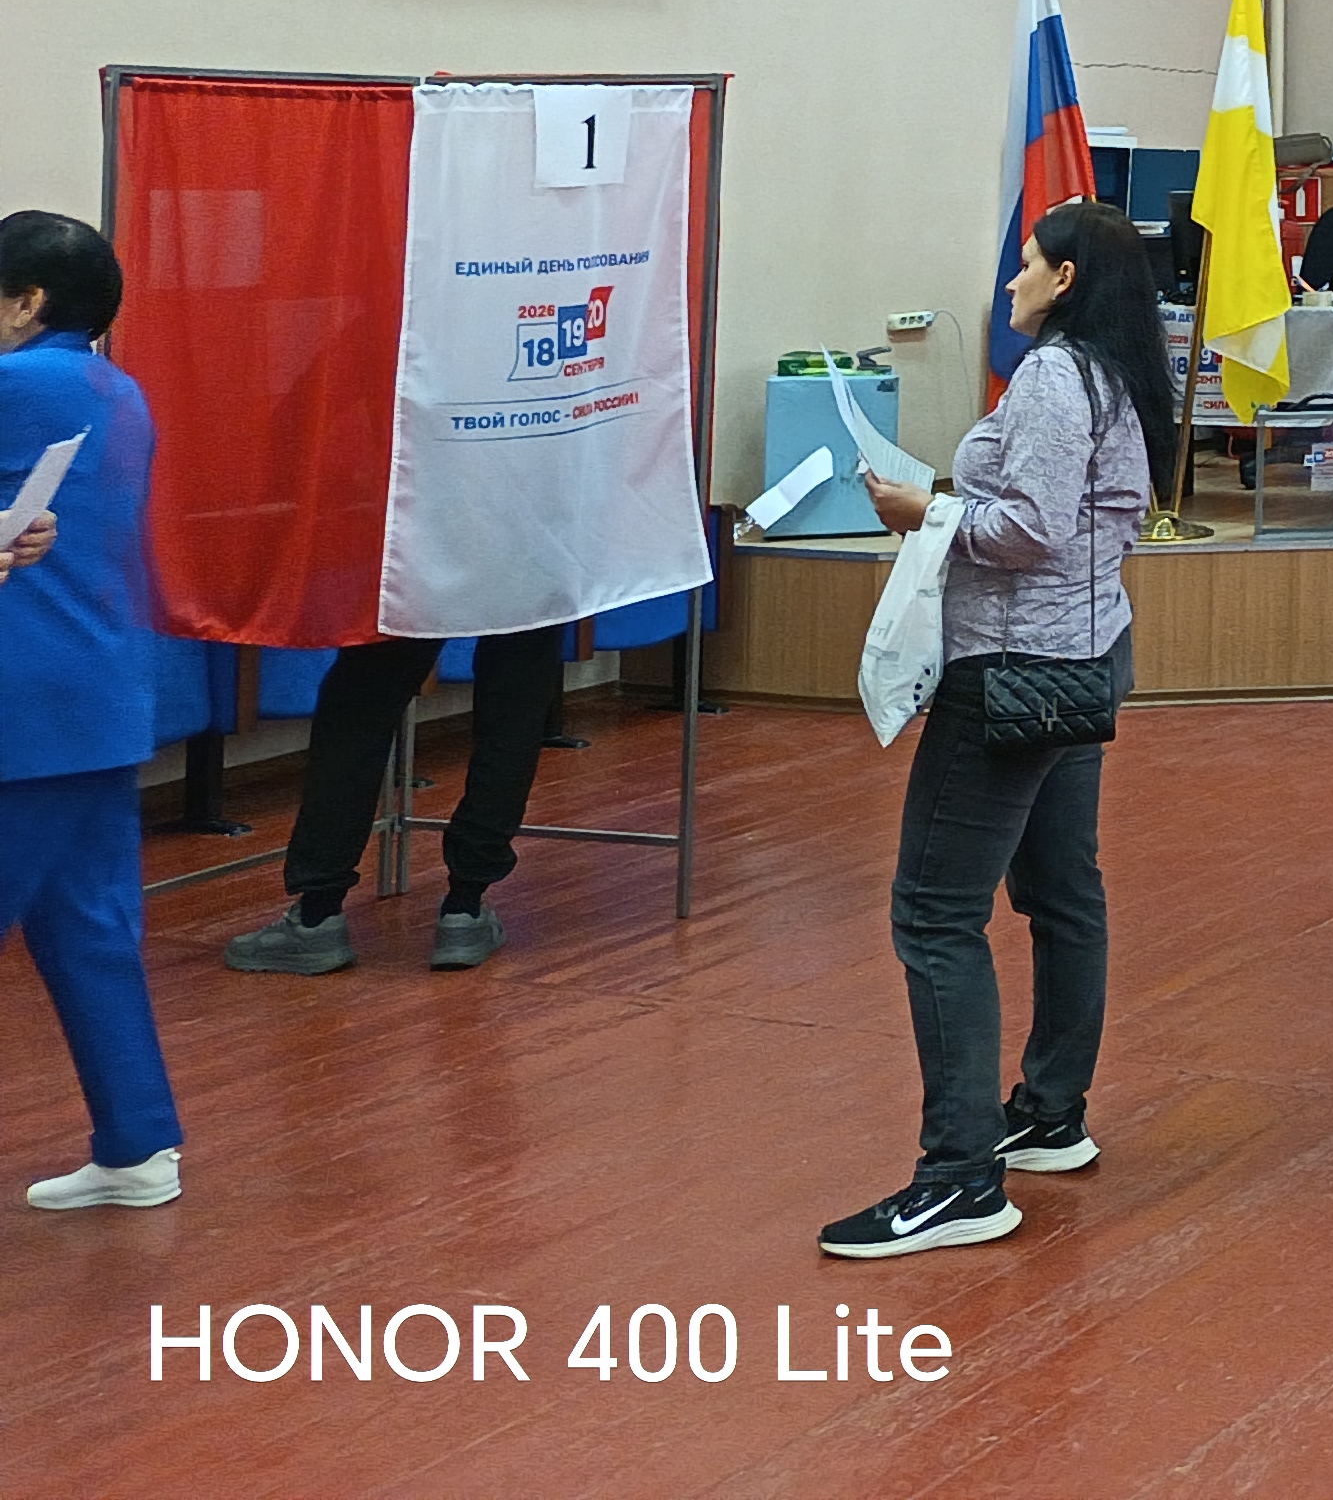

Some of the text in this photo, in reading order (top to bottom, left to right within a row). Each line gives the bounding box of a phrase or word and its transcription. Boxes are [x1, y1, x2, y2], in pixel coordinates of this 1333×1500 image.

[581, 114, 597, 170] 1
[455, 257, 533, 276] ЕДИНЫЙ
[537, 259, 575, 275] ДЕНЬ
[518, 304, 555, 319] 2026
[522, 337, 555, 367] 18
[562, 317, 585, 348] 19
[1170, 356, 1189, 375] 18
[451, 411, 505, 430] ТВОЙ
[510, 409, 561, 427] ГОЛОС
